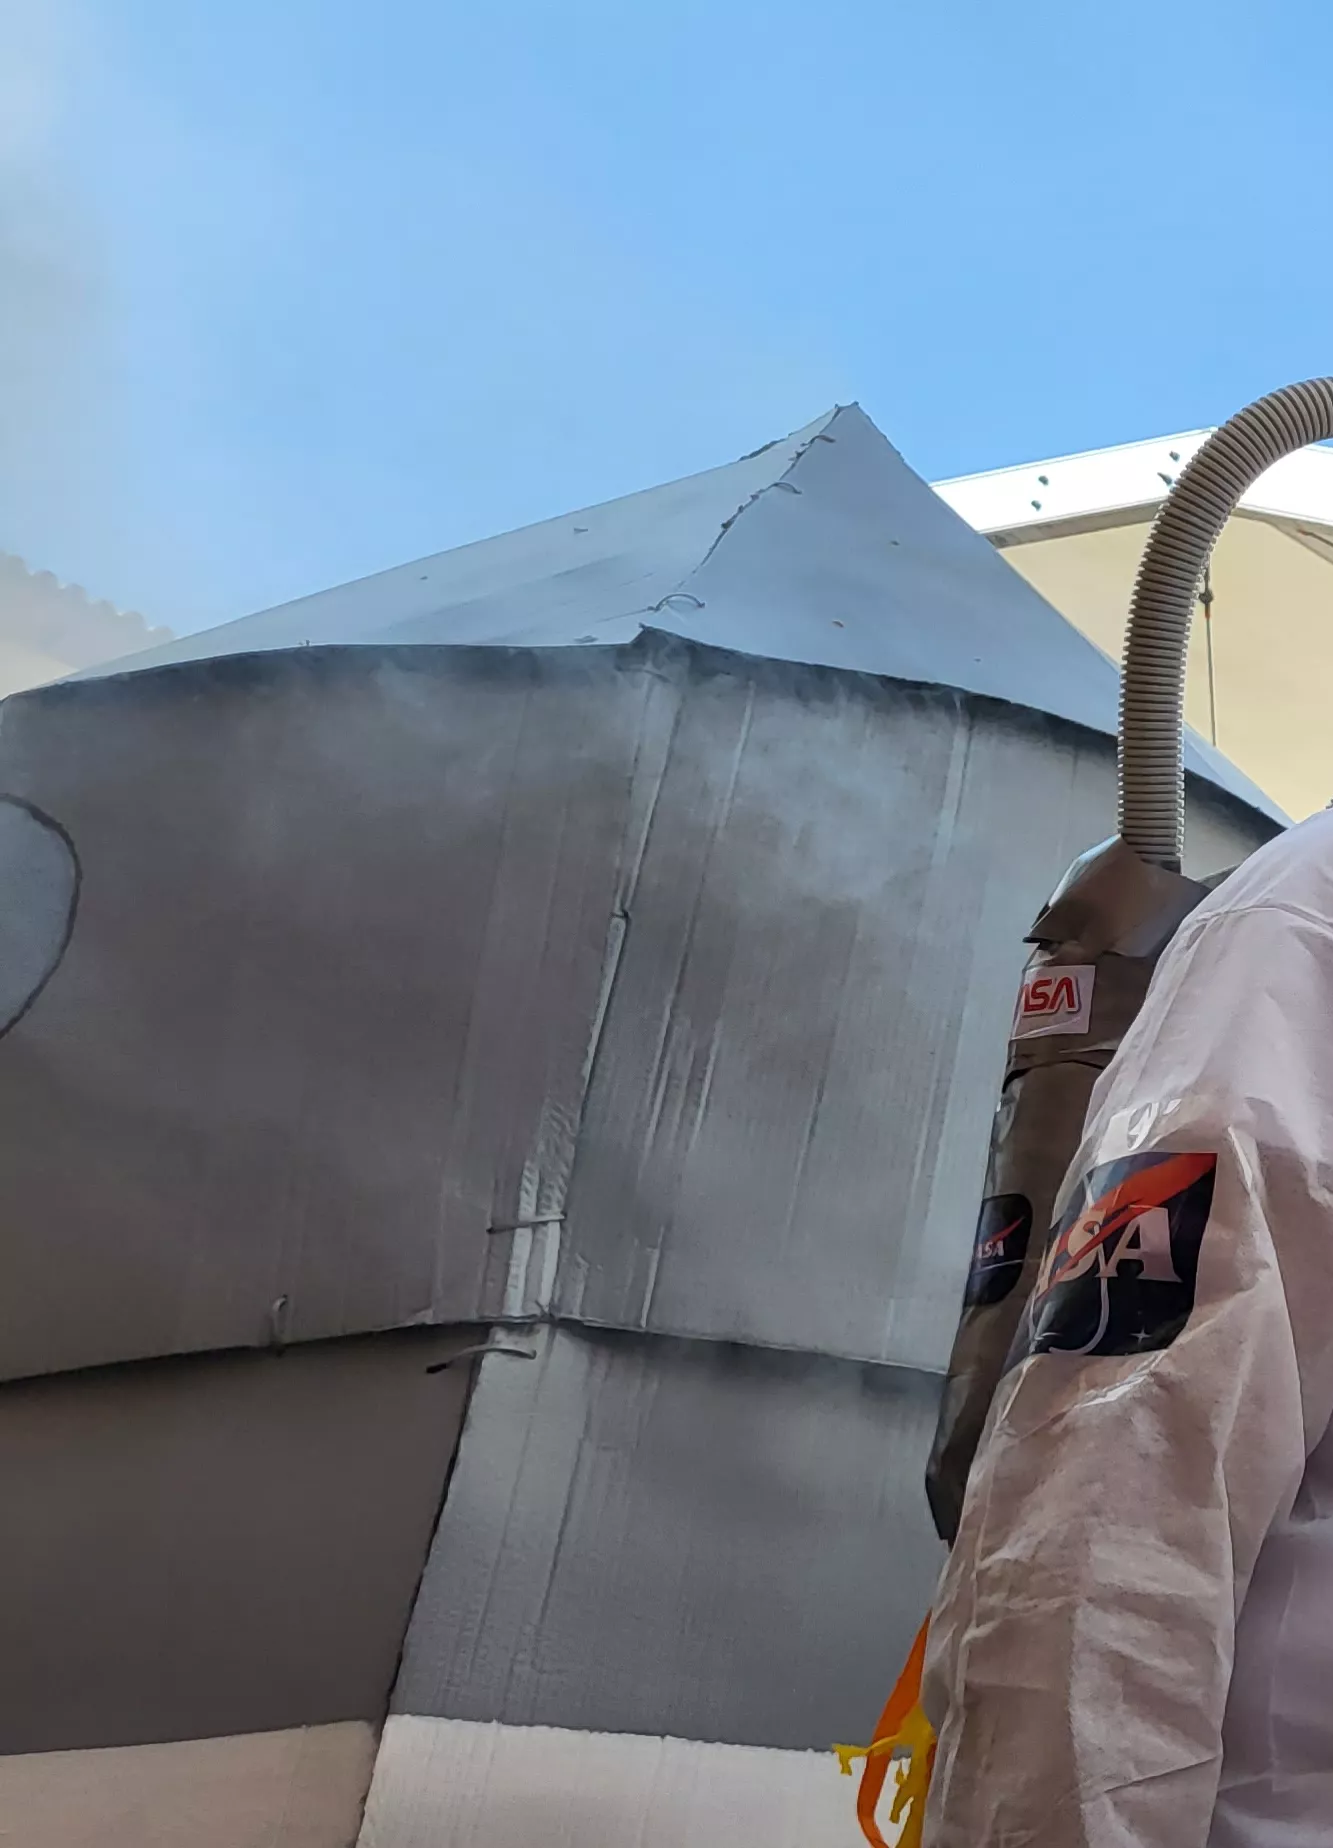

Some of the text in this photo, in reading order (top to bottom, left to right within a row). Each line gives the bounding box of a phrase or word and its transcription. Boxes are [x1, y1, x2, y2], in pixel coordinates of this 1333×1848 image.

[1024, 976, 1076, 1012] SA
[976, 1240, 1005, 1259] SA
[1038, 1204, 1183, 1292] SA
